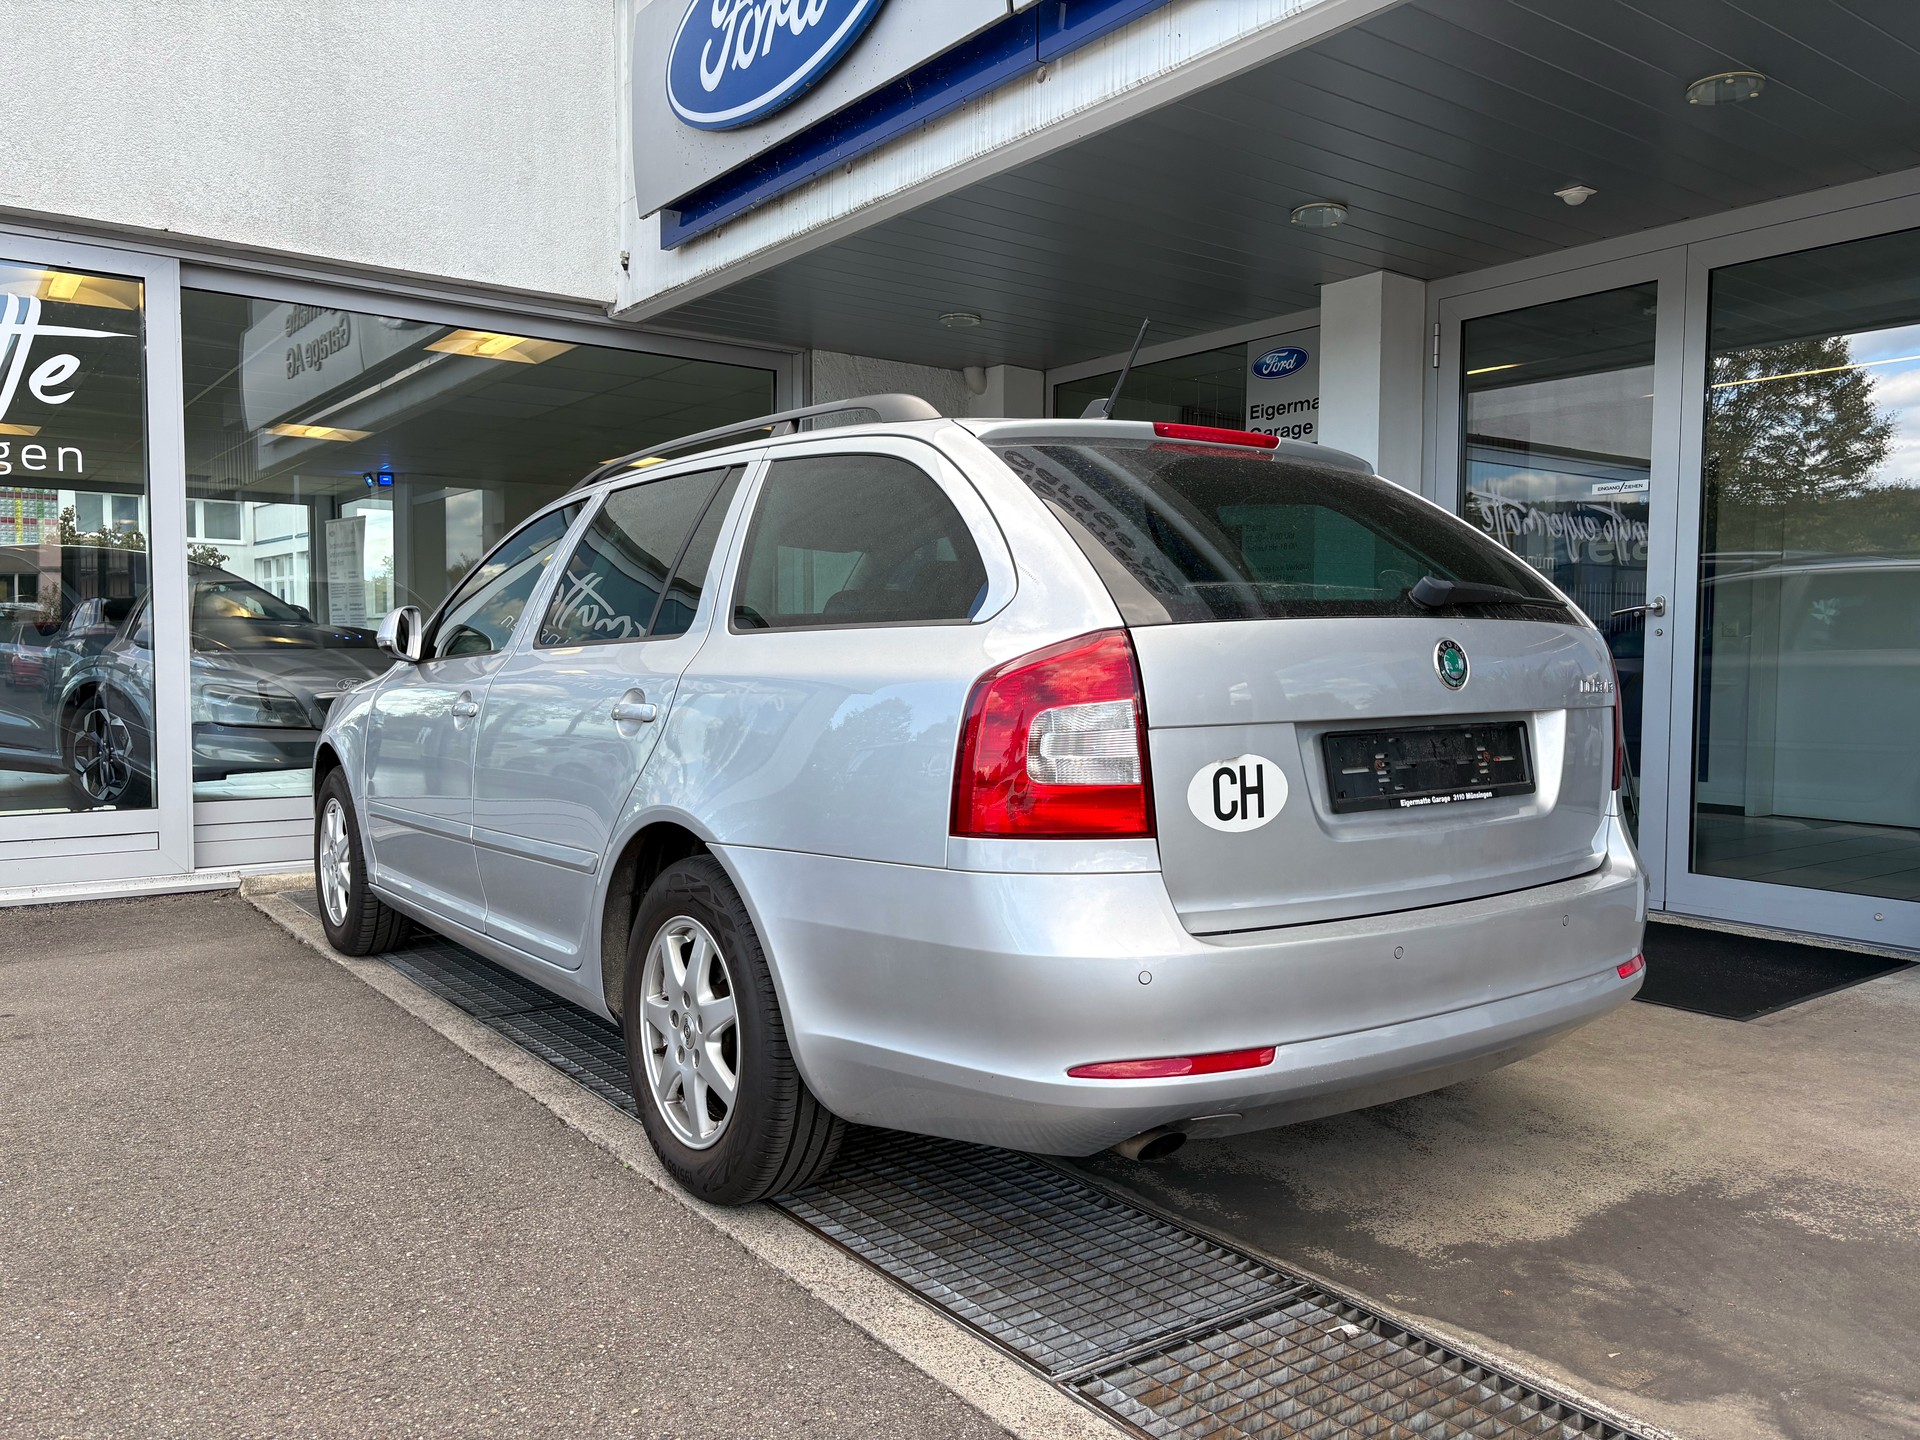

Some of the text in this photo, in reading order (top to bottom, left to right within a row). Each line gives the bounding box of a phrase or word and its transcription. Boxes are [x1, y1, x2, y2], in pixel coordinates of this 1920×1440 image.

[1262, 351, 1298, 375] Ford
[1212, 763, 1265, 821] CH
[1400, 797, 1431, 807] Eigermatte
[1431, 795, 1451, 804] Garage
